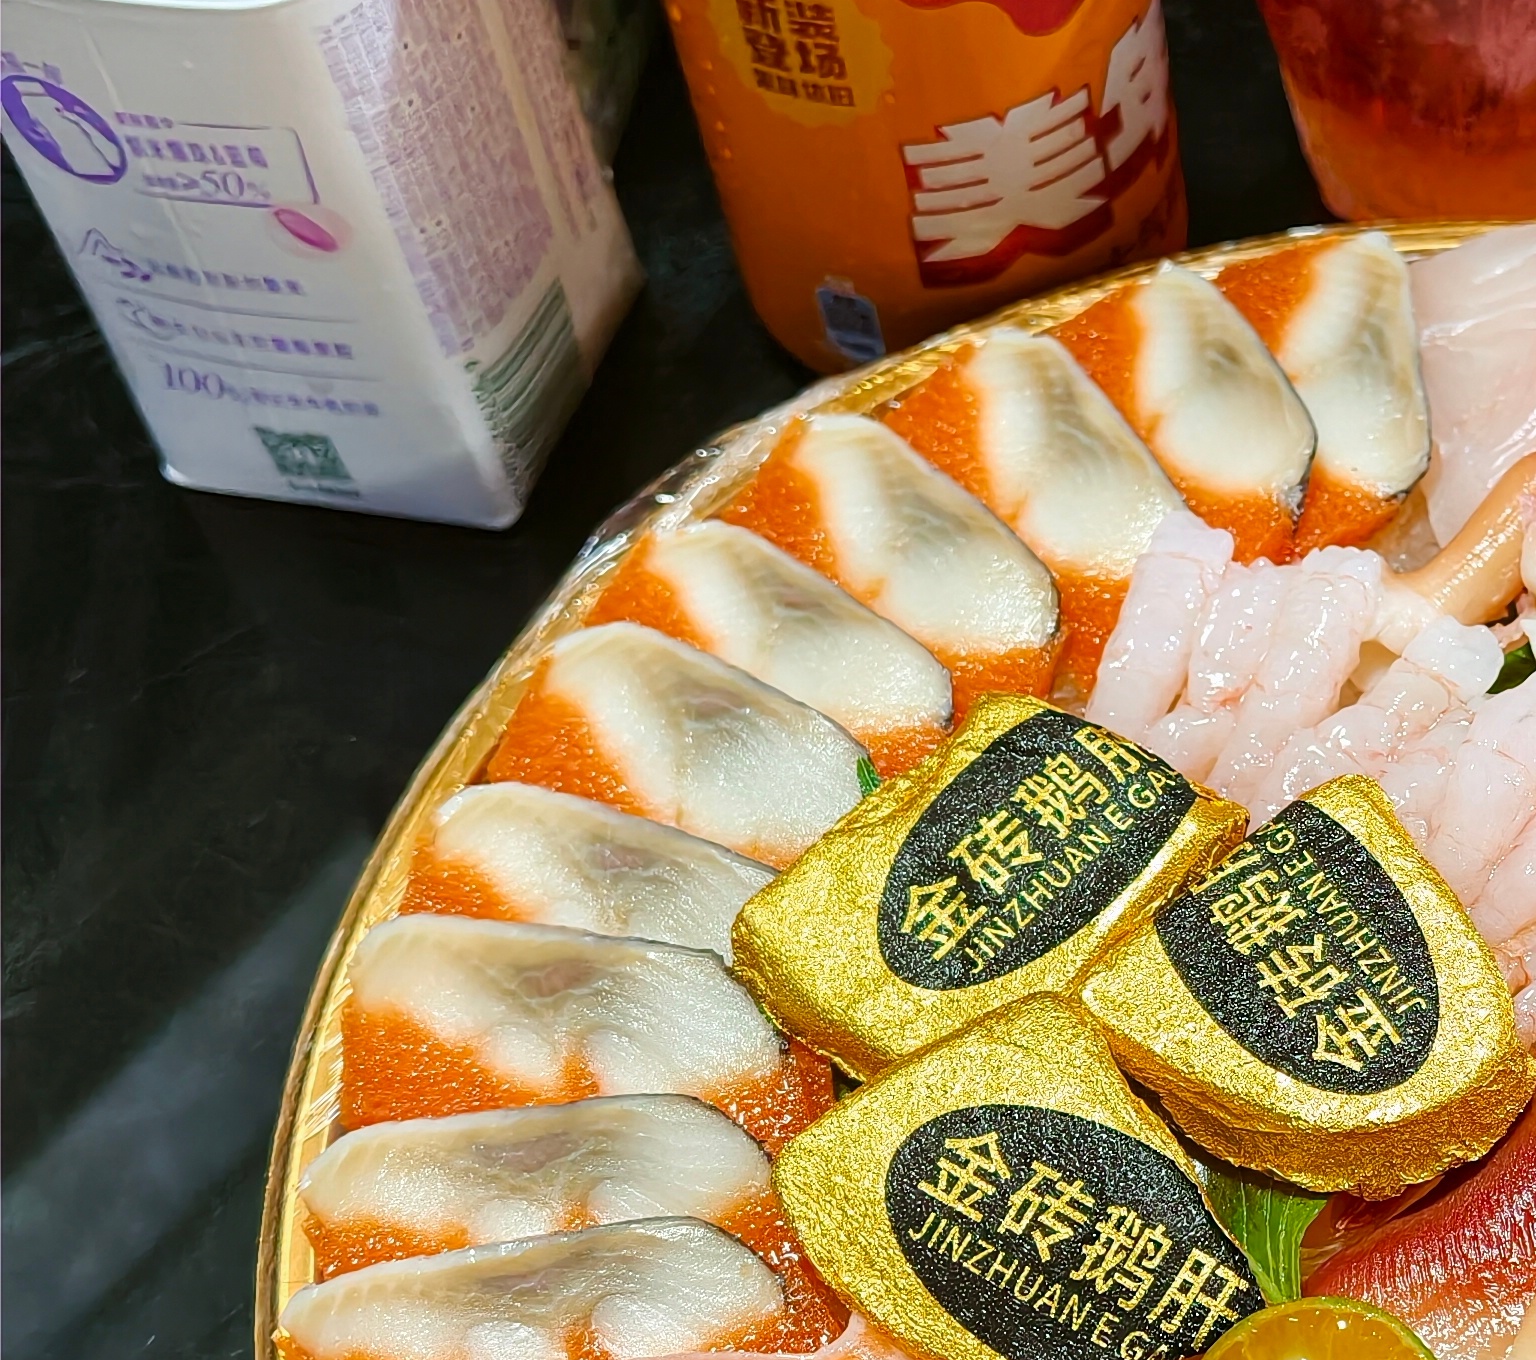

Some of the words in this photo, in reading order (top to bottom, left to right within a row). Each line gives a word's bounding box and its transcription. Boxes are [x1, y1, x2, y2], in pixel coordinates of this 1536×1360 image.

[742, 25, 848, 81] 登场
[963, 824, 1112, 974] JINZHUAN
[1127, 767, 1180, 810] GA
[1298, 871, 1426, 1014] JINZHUAN
[908, 1213, 1093, 1332] JINZHUAN
[917, 1131, 1248, 1352] 金砖鹅肝
